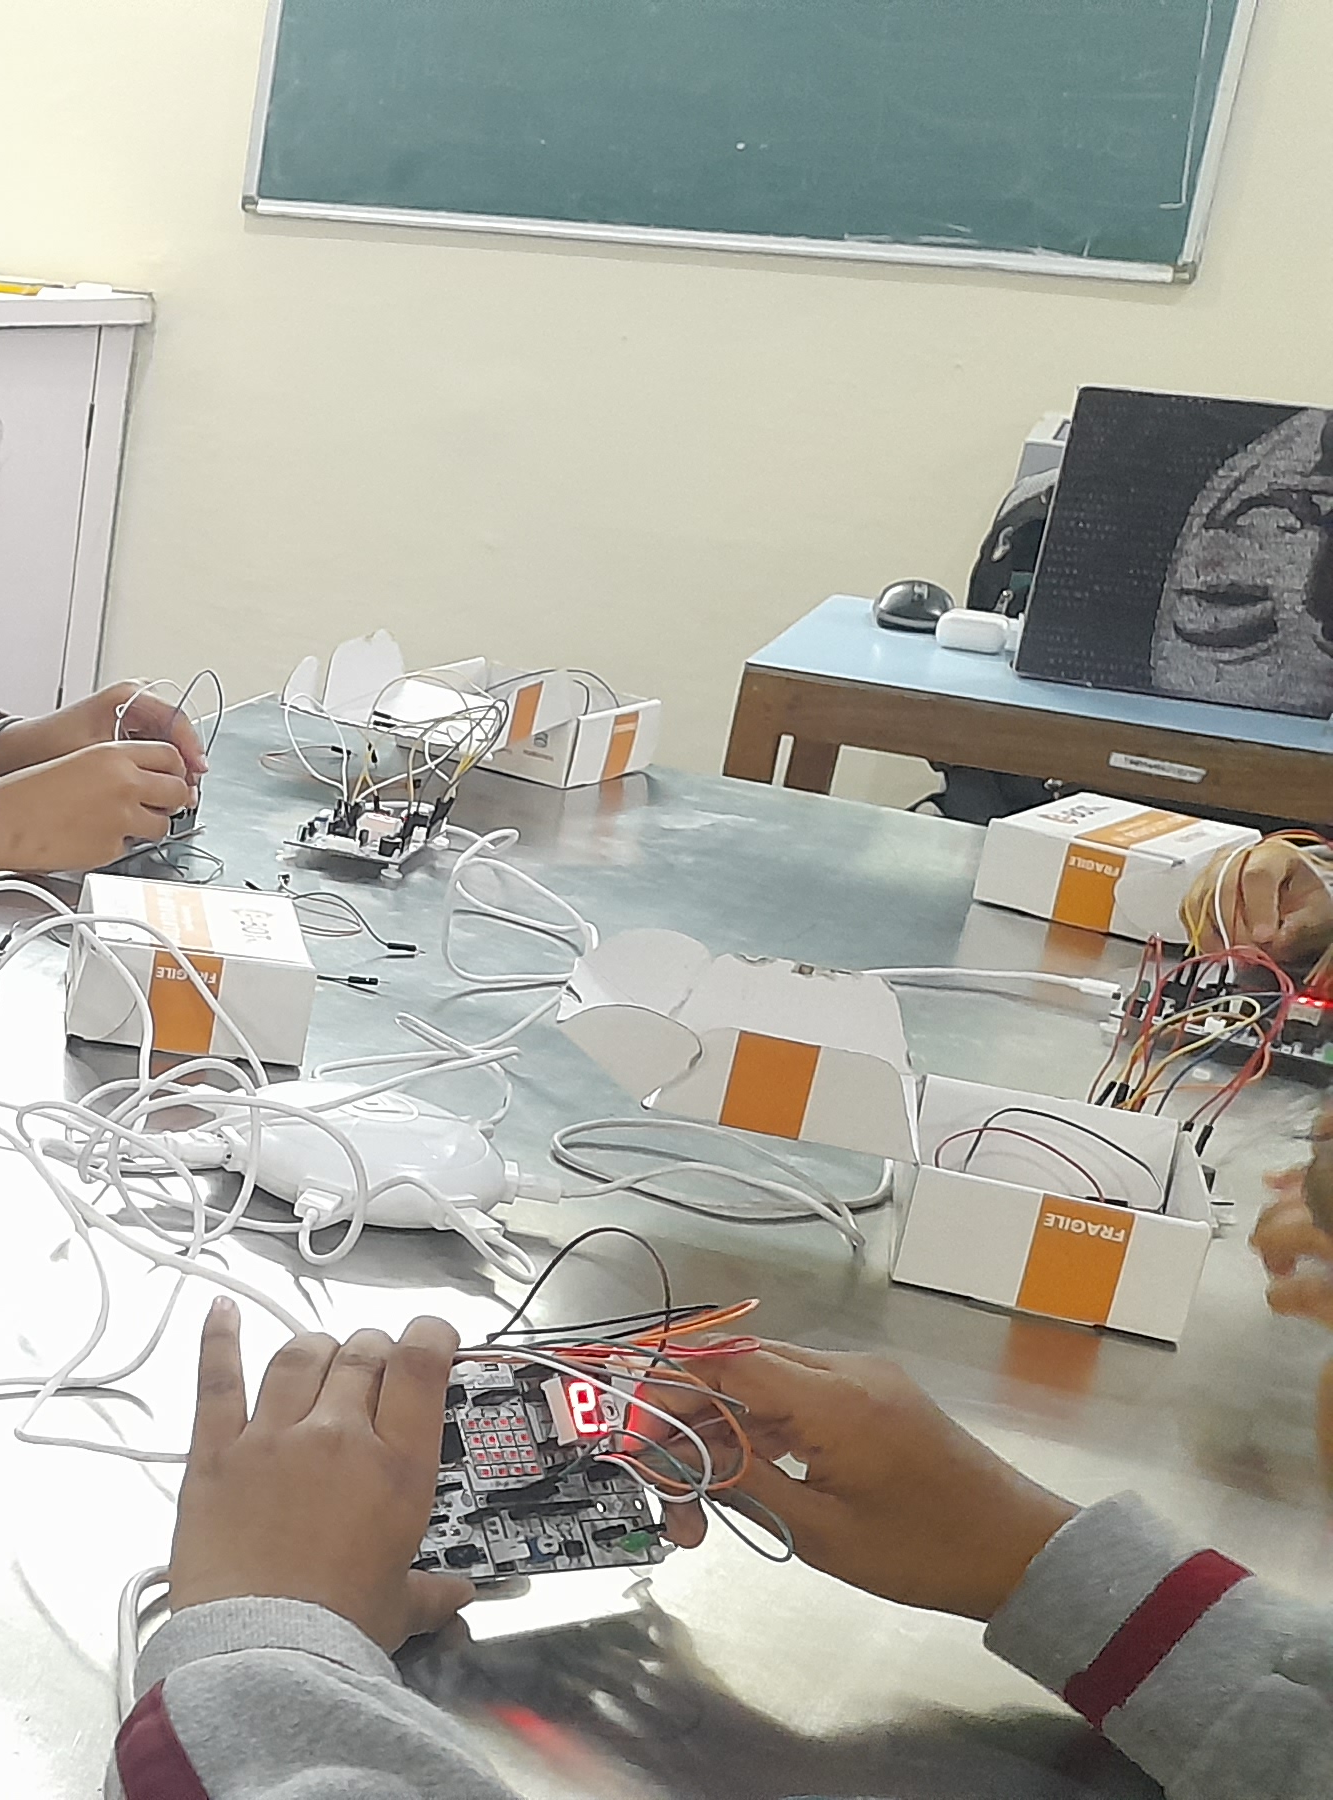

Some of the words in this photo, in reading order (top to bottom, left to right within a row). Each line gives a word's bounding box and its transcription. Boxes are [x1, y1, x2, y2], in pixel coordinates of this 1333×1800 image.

[1067, 854, 1121, 878] FRAGILE
[155, 965, 217, 985] FRGILE
[1043, 1212, 1128, 1243] FRAGILE
